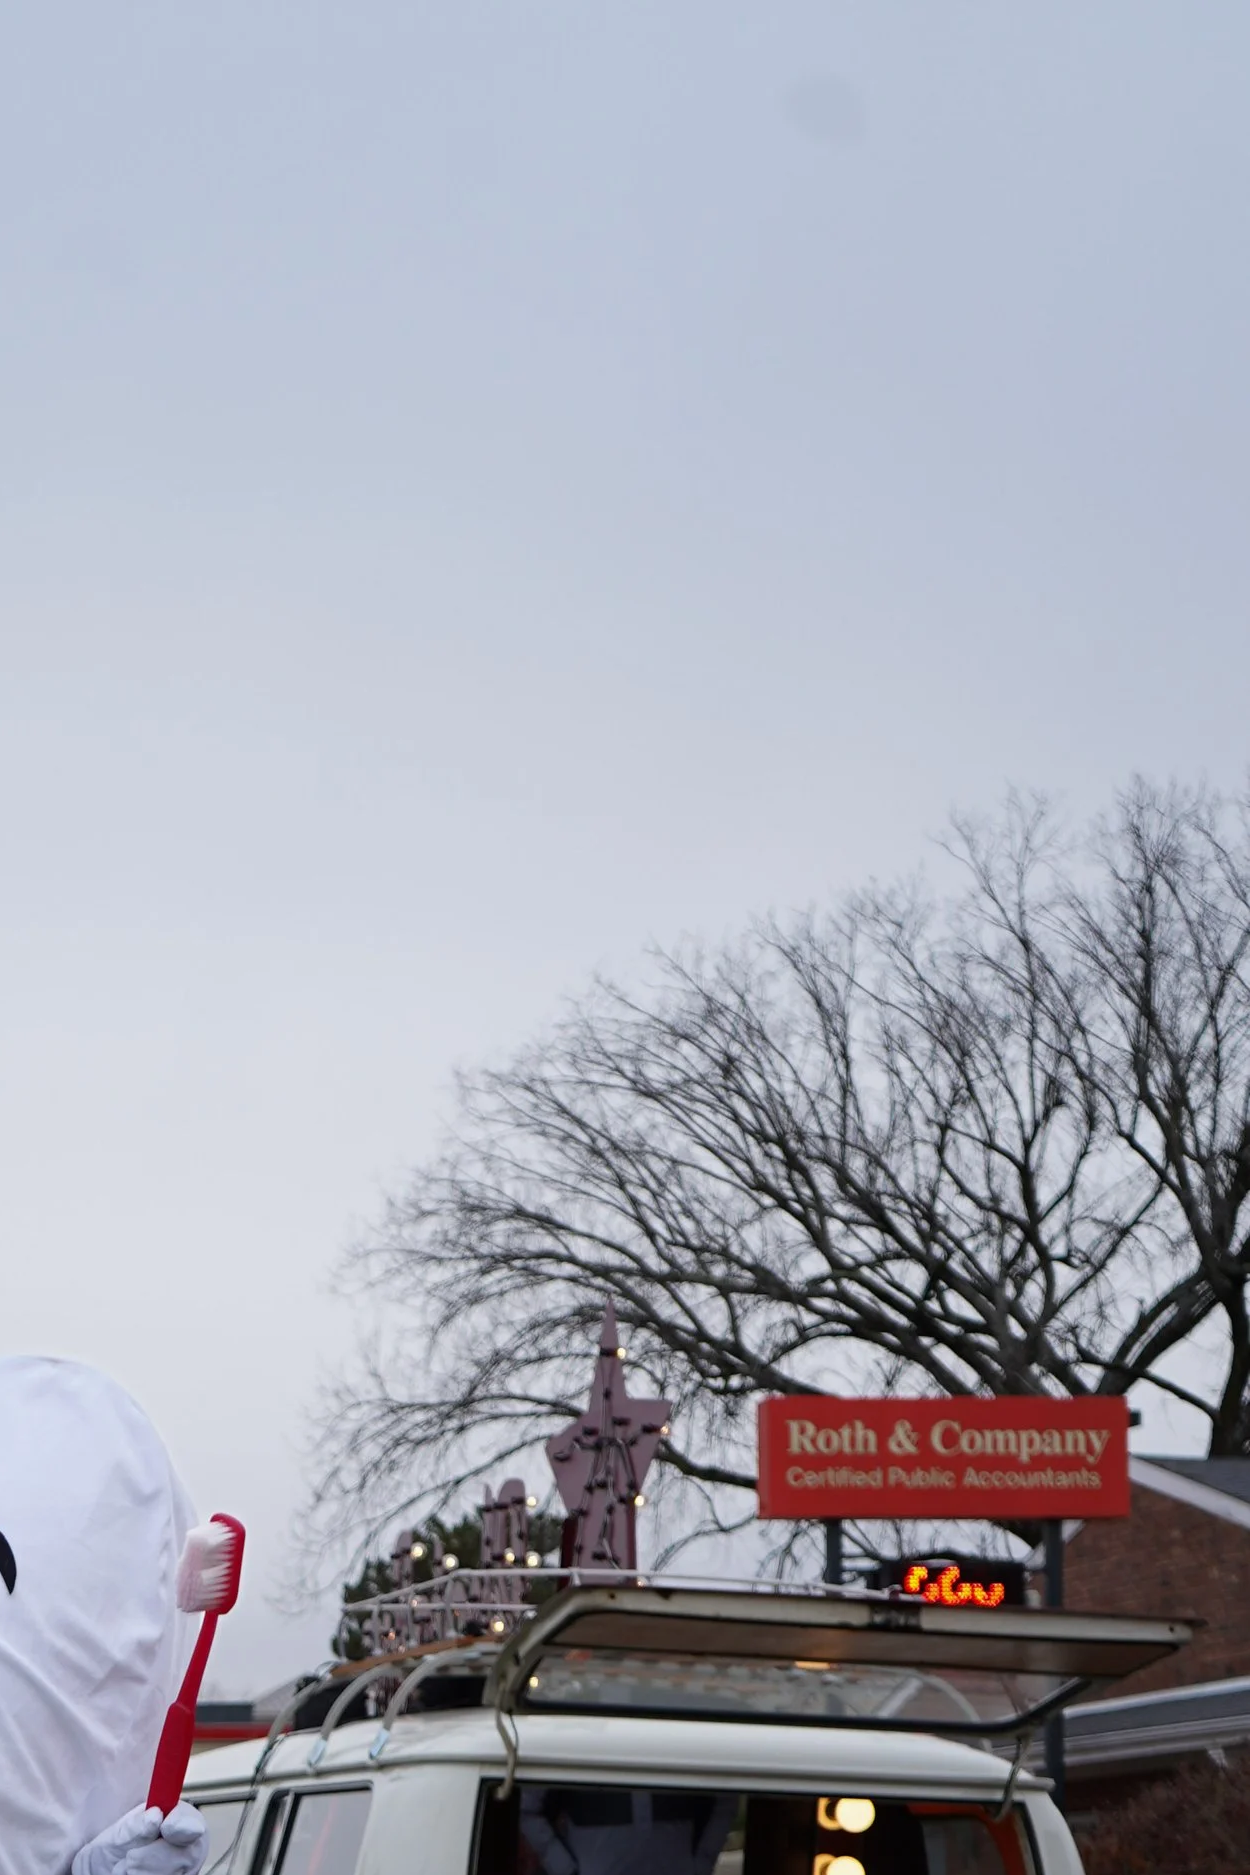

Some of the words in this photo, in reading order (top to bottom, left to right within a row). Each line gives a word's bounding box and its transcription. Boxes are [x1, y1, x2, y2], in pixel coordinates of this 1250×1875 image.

[785, 1420, 878, 1455] Roth
[887, 1419, 919, 1455] &
[930, 1420, 1111, 1464] Company
[785, 1467, 883, 1488] Certified
[888, 1467, 956, 1488] Public
[963, 1467, 1102, 1489] Accountants
